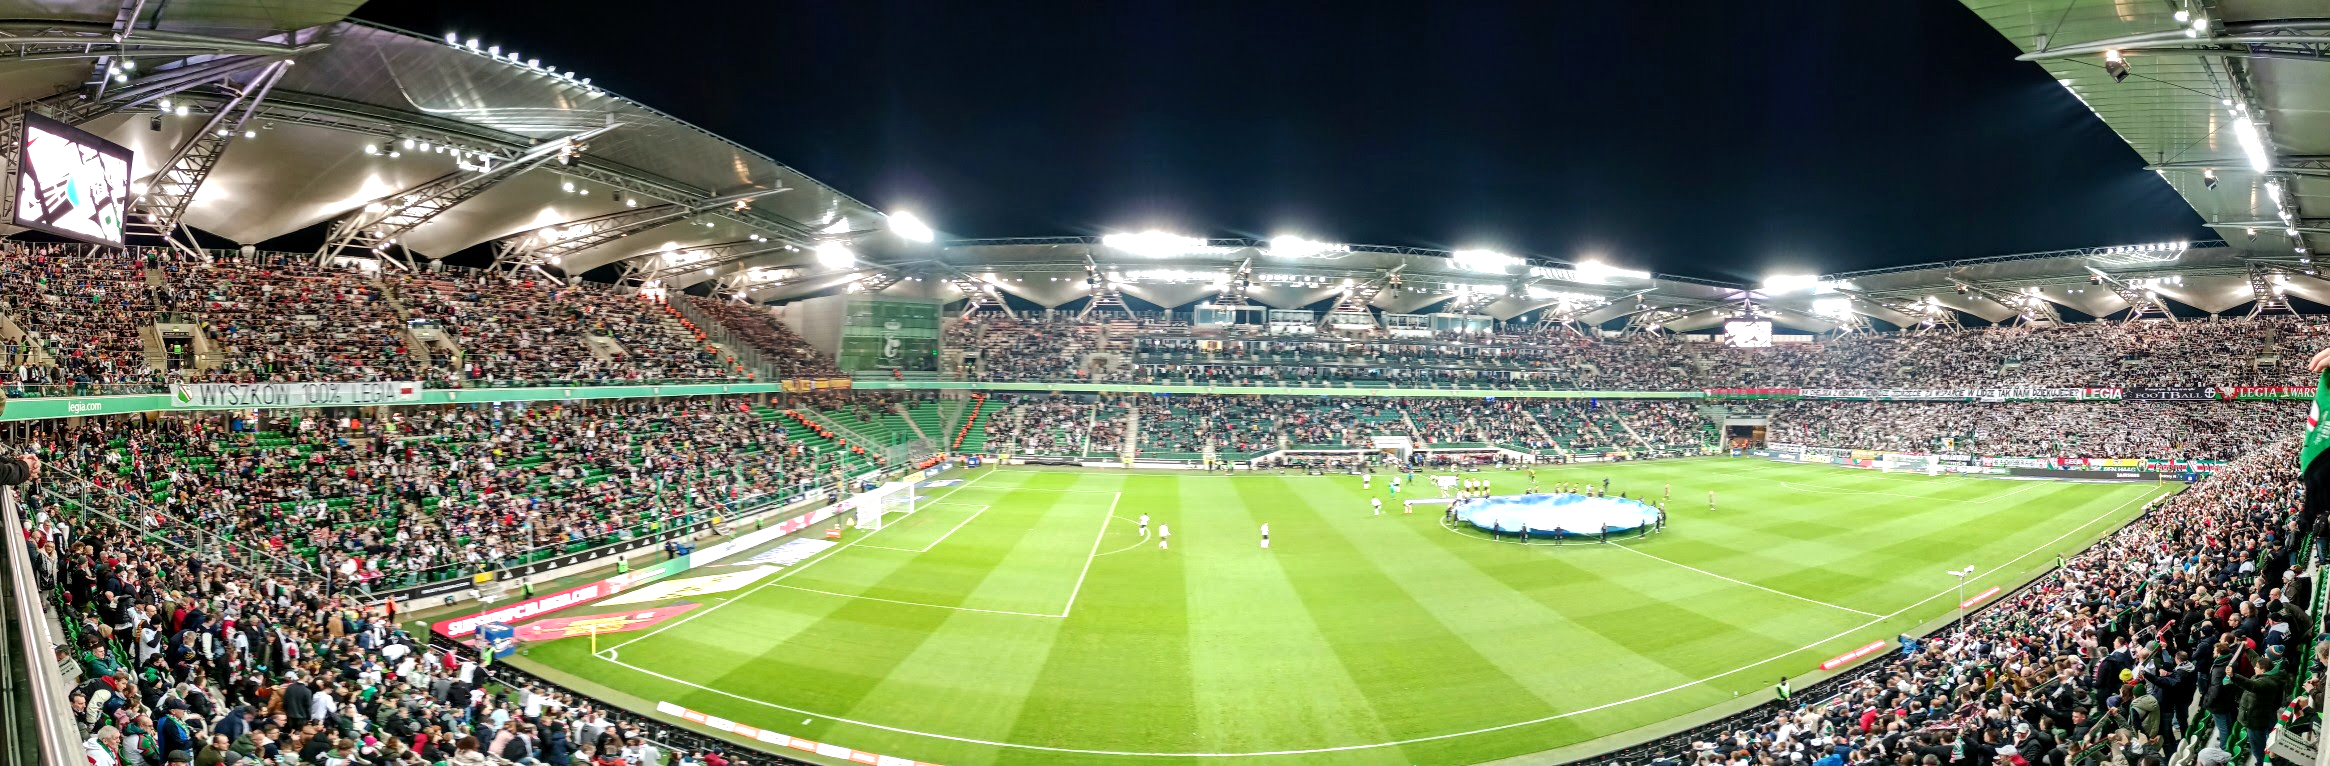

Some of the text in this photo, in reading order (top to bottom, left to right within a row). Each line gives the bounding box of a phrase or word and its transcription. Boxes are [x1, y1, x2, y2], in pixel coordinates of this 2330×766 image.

[200, 383, 396, 406] WYSZKÓW 100% LEGIA
[1998, 389, 2011, 397] TAK
[2013, 389, 2030, 397] NAM
[2083, 388, 2122, 399] LEGIA
[2239, 387, 2316, 398] LEGIA WARS
[68, 401, 102, 414] legia.com
